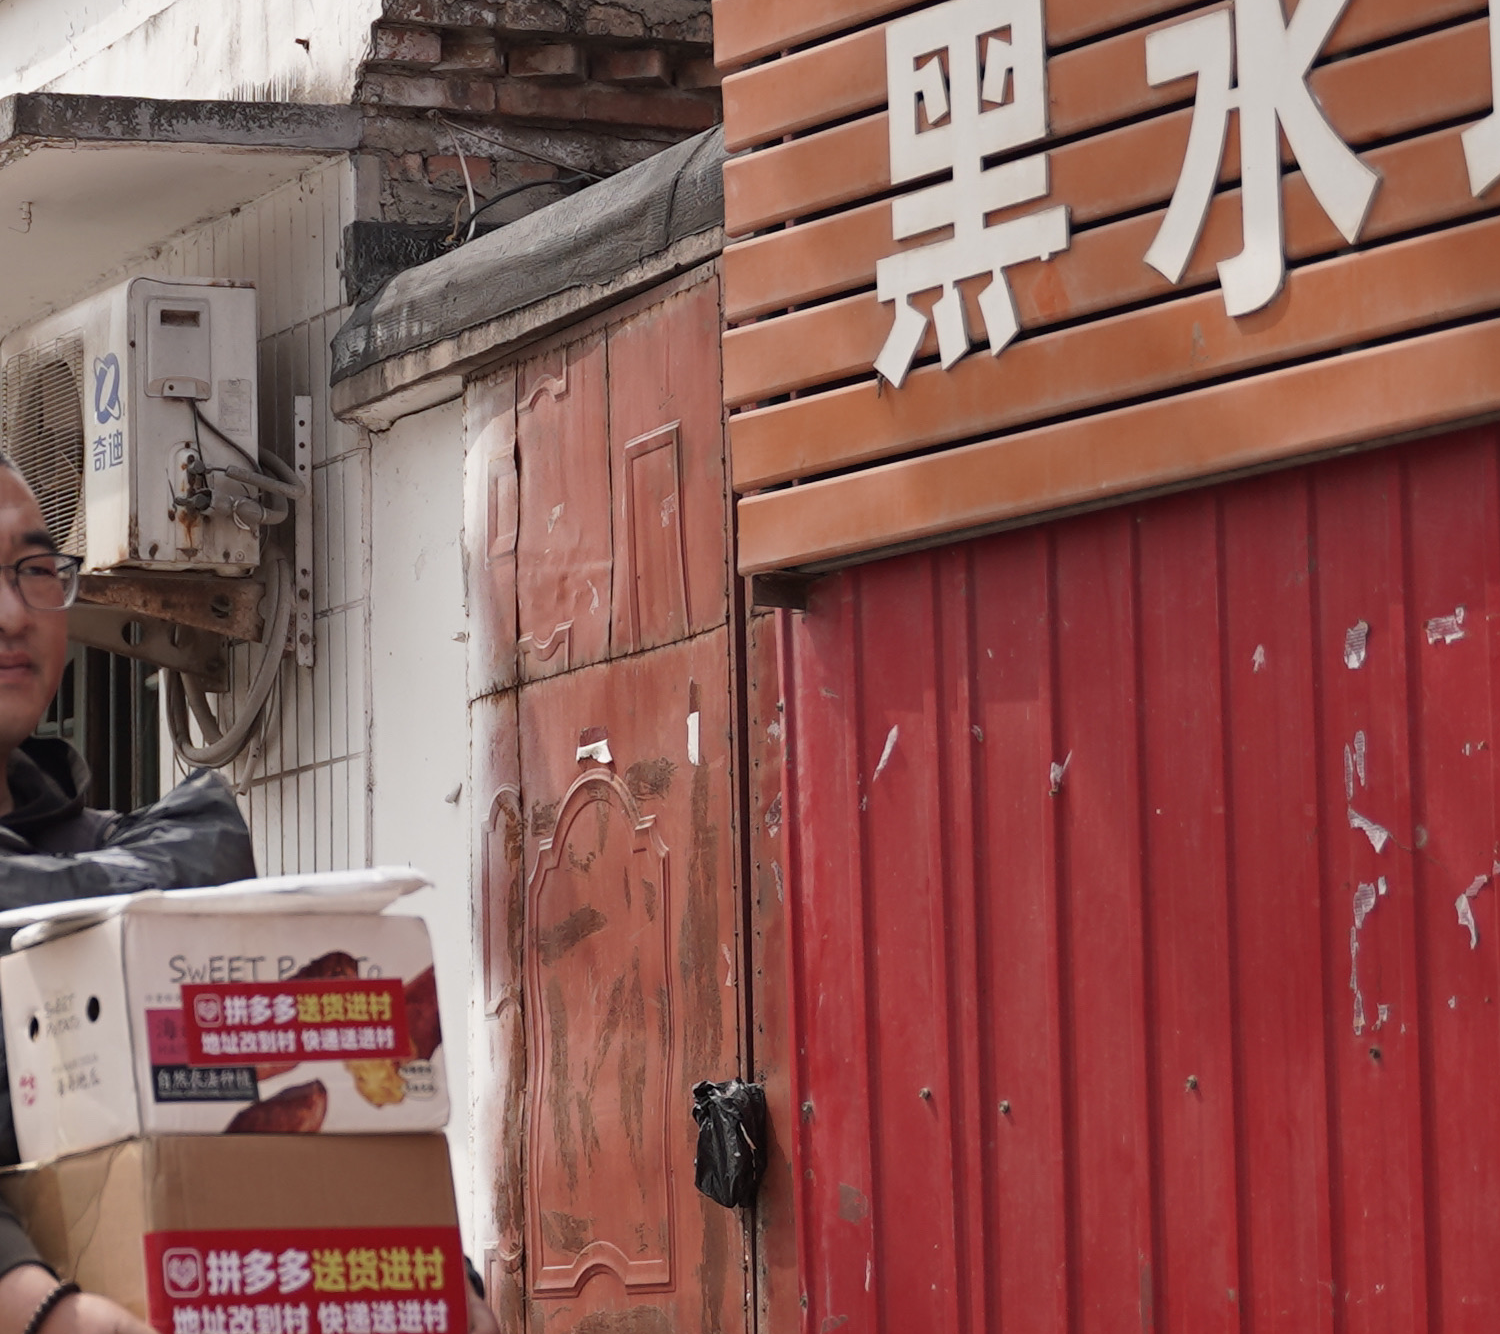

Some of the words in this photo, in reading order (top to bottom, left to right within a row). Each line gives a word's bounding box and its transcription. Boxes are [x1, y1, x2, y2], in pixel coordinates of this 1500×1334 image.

[93, 429, 124, 472] 奇迪
[223, 991, 392, 1026] 拼多多送货进村
[206, 1247, 444, 1296] 拼多多送货进村
